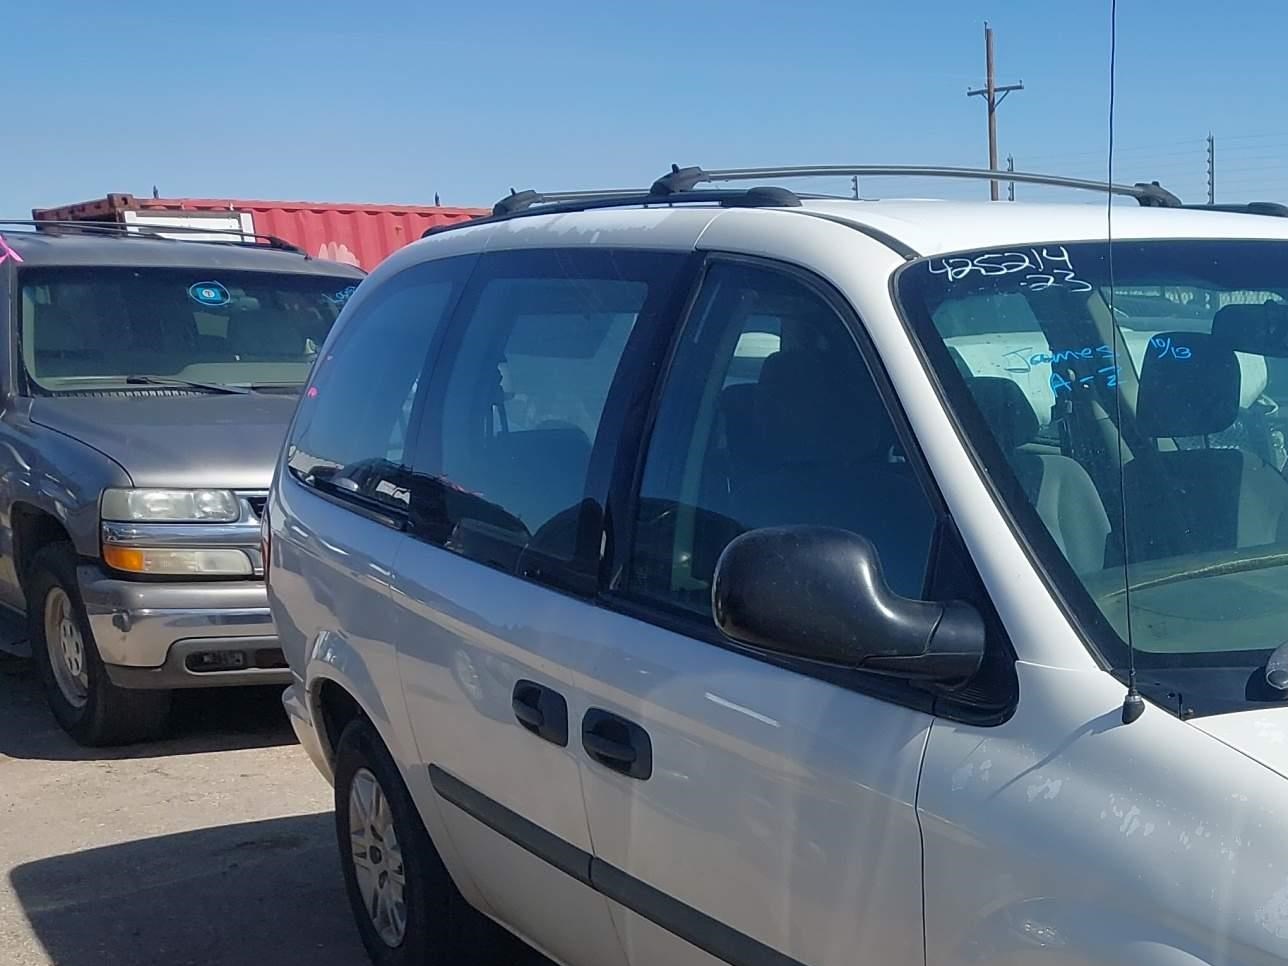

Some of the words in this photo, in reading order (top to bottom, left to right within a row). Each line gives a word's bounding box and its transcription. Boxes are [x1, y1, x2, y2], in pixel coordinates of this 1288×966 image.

[928, 246, 1073, 282] 425214
[1002, 346, 1120, 374] James
[1151, 337, 1192, 359] 10/13
